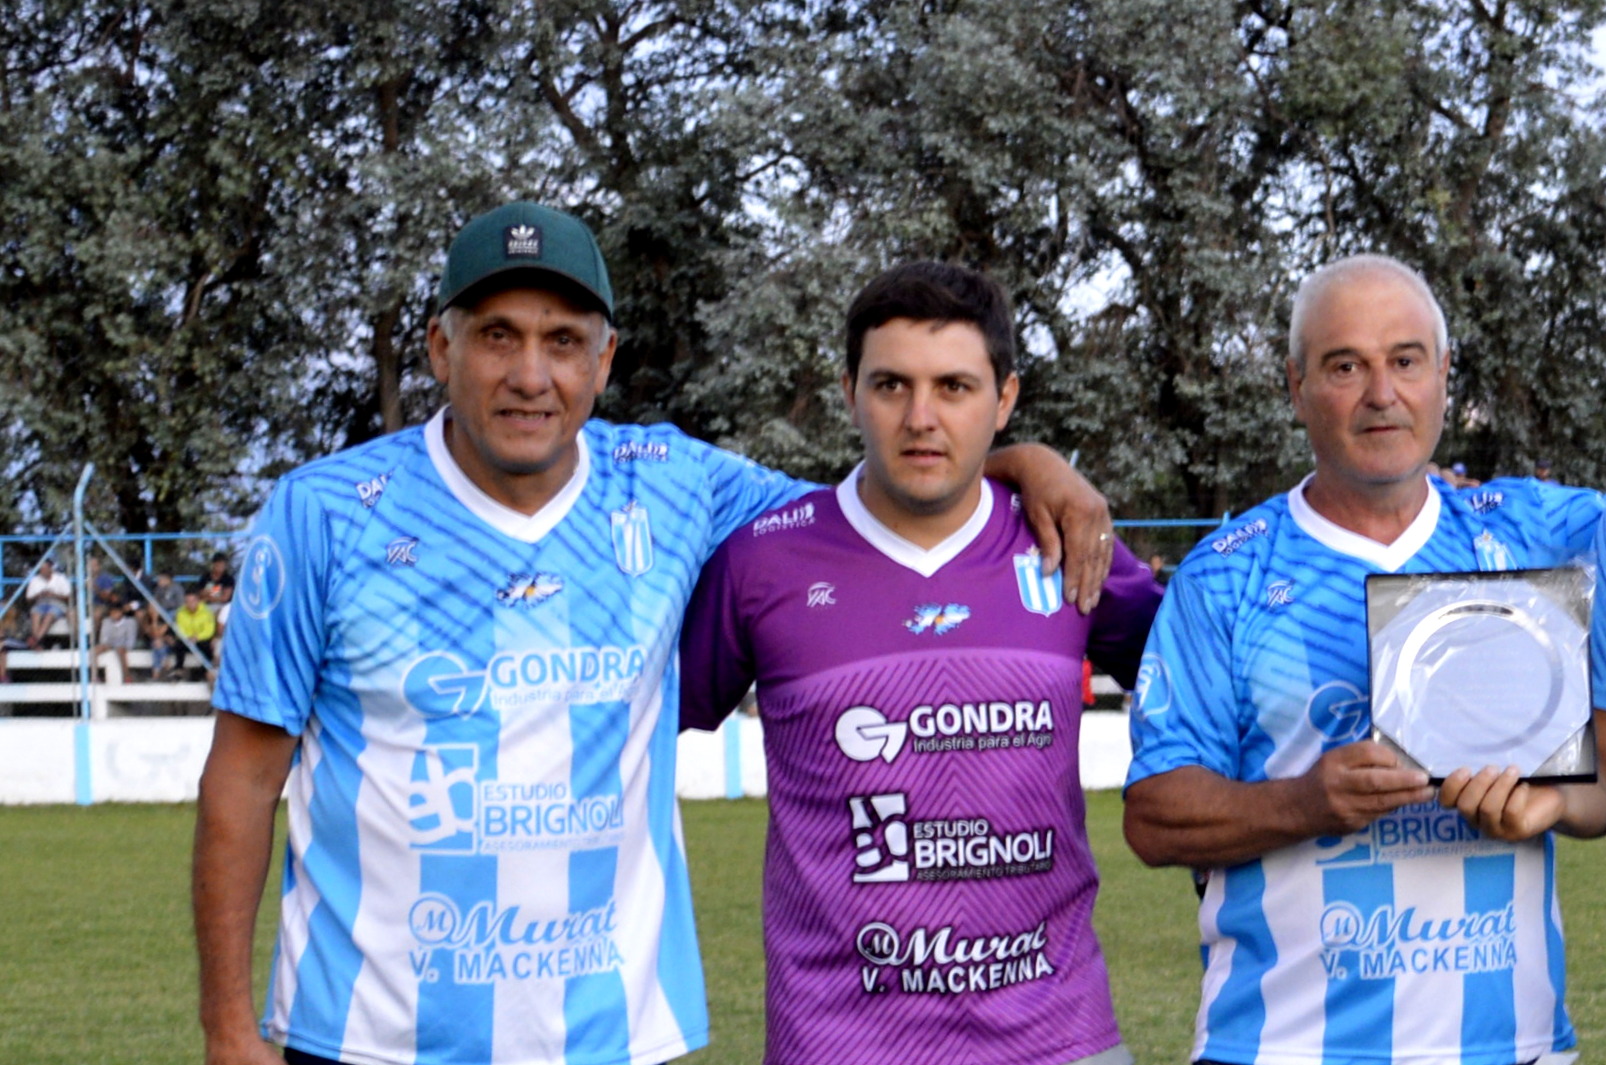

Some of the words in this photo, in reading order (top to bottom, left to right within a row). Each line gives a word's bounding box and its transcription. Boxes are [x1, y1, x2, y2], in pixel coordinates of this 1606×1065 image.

[490, 649, 645, 688] GONDRA
[909, 700, 1054, 738] GONDRA
[913, 736, 975, 752] Industria
[978, 736, 1009, 751] para
[483, 783, 567, 801] ESTUDIO
[483, 798, 625, 838] BRIGNOLI
[913, 819, 989, 839] ESTUDIO
[1377, 813, 1481, 847] BRIGN
[914, 829, 1053, 869] BRIGNOLI
[457, 939, 625, 980] MACKENNA
[862, 966, 886, 993] V.
[902, 951, 1055, 993] MACKENNA
[1362, 942, 1518, 978] MACKENNA
